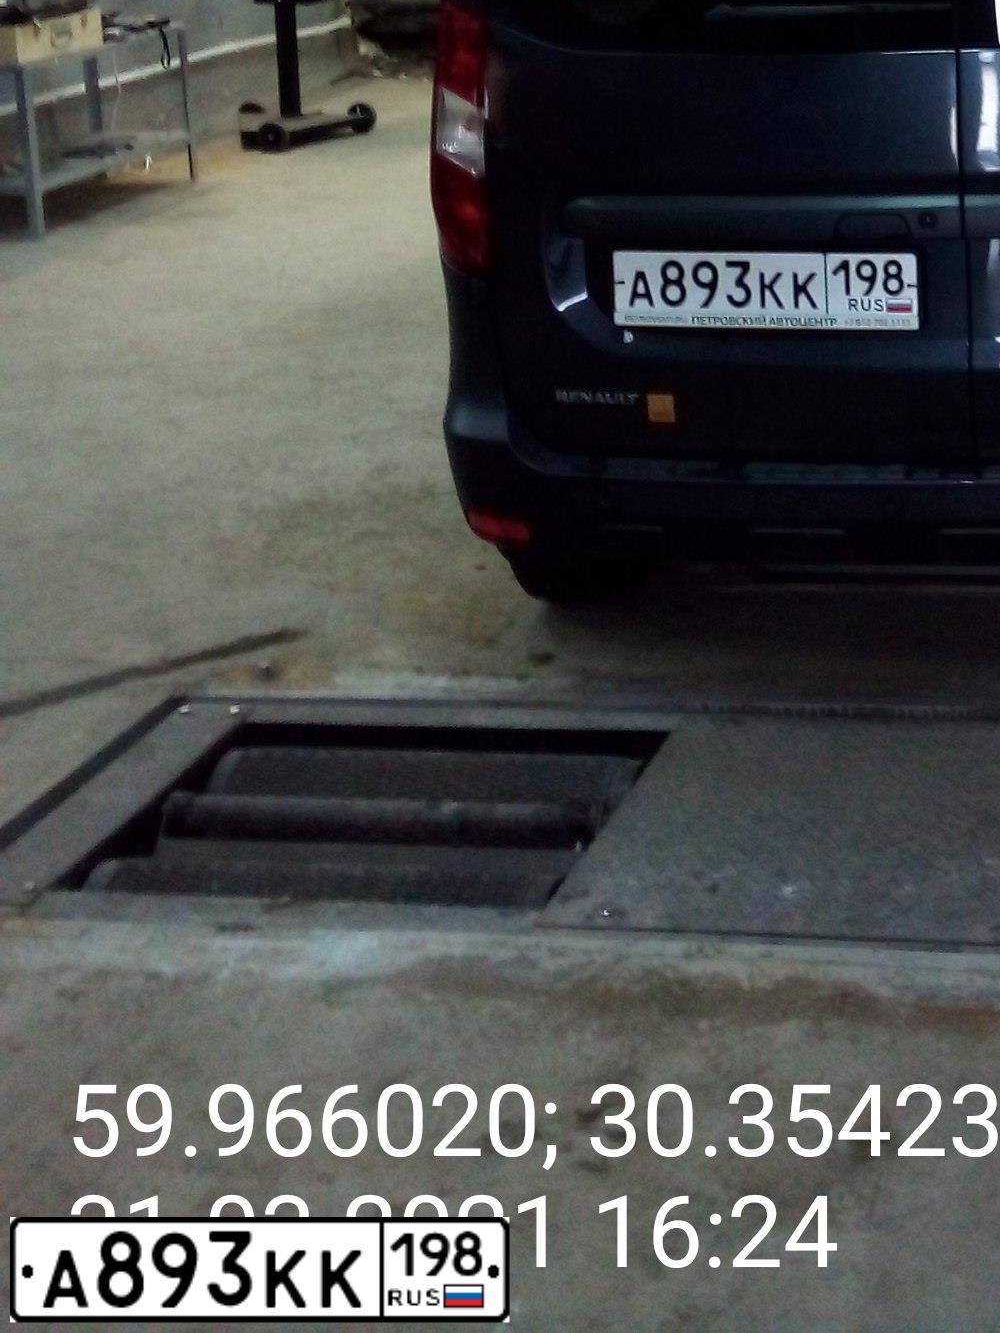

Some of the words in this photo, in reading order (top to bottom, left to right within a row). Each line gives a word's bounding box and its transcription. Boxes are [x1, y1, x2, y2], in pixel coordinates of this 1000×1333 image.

[628, 259, 820, 309] А893КК
[832, 259, 905, 297] 198
[848, 298, 885, 313] RUS
[691, 314, 766, 327] ПЕТРОВСКИЙ
[769, 316, 838, 328] АВТОЦЕНТР
[555, 388, 640, 405] RENAULT
